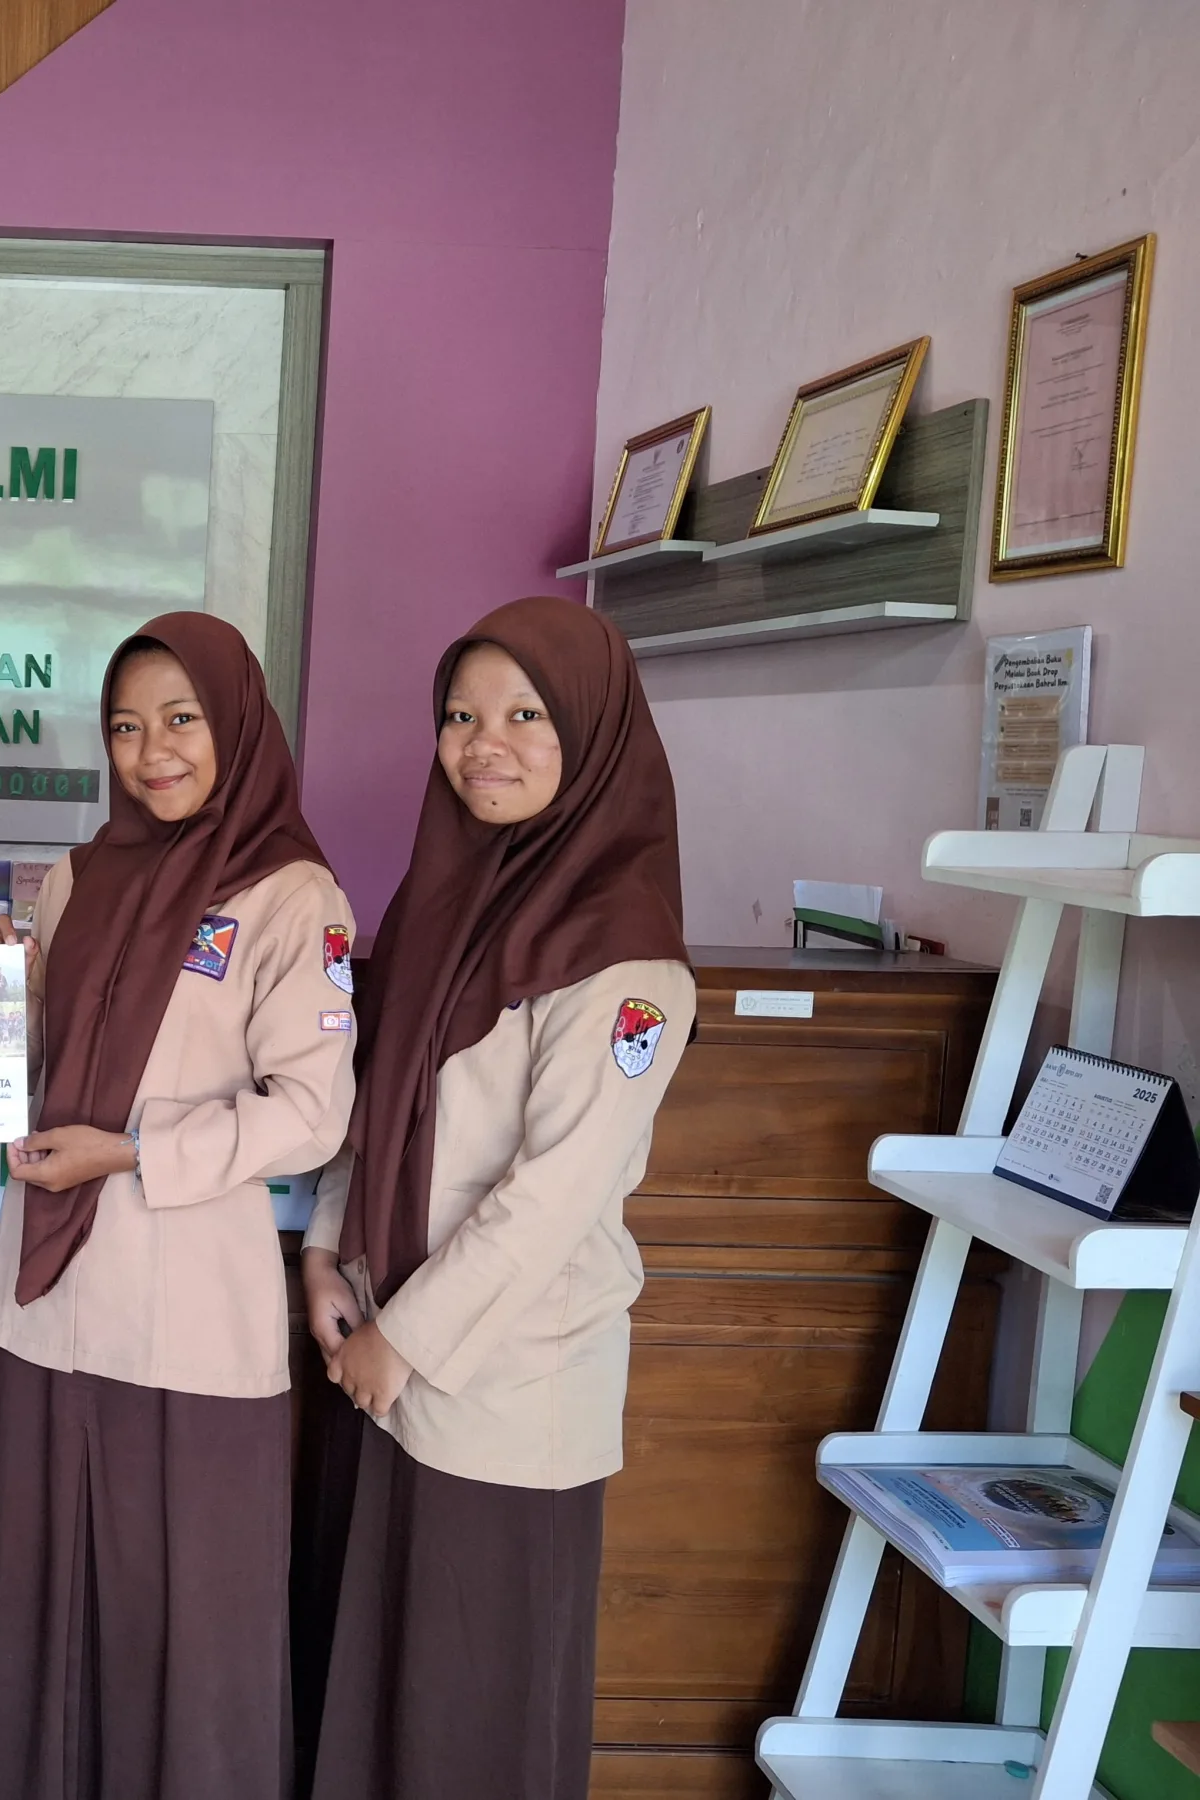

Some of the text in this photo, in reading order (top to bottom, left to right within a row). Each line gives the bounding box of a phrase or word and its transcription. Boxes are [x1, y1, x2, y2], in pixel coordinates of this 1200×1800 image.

[1004, 654, 1062, 668] Pengembalian Buku
[1042, 667, 1058, 678] Drop
[1035, 678, 1057, 689] Bahrul
[1093, 1093, 1113, 1103] AGUSTUS
[1132, 1087, 1158, 1104] 2025
